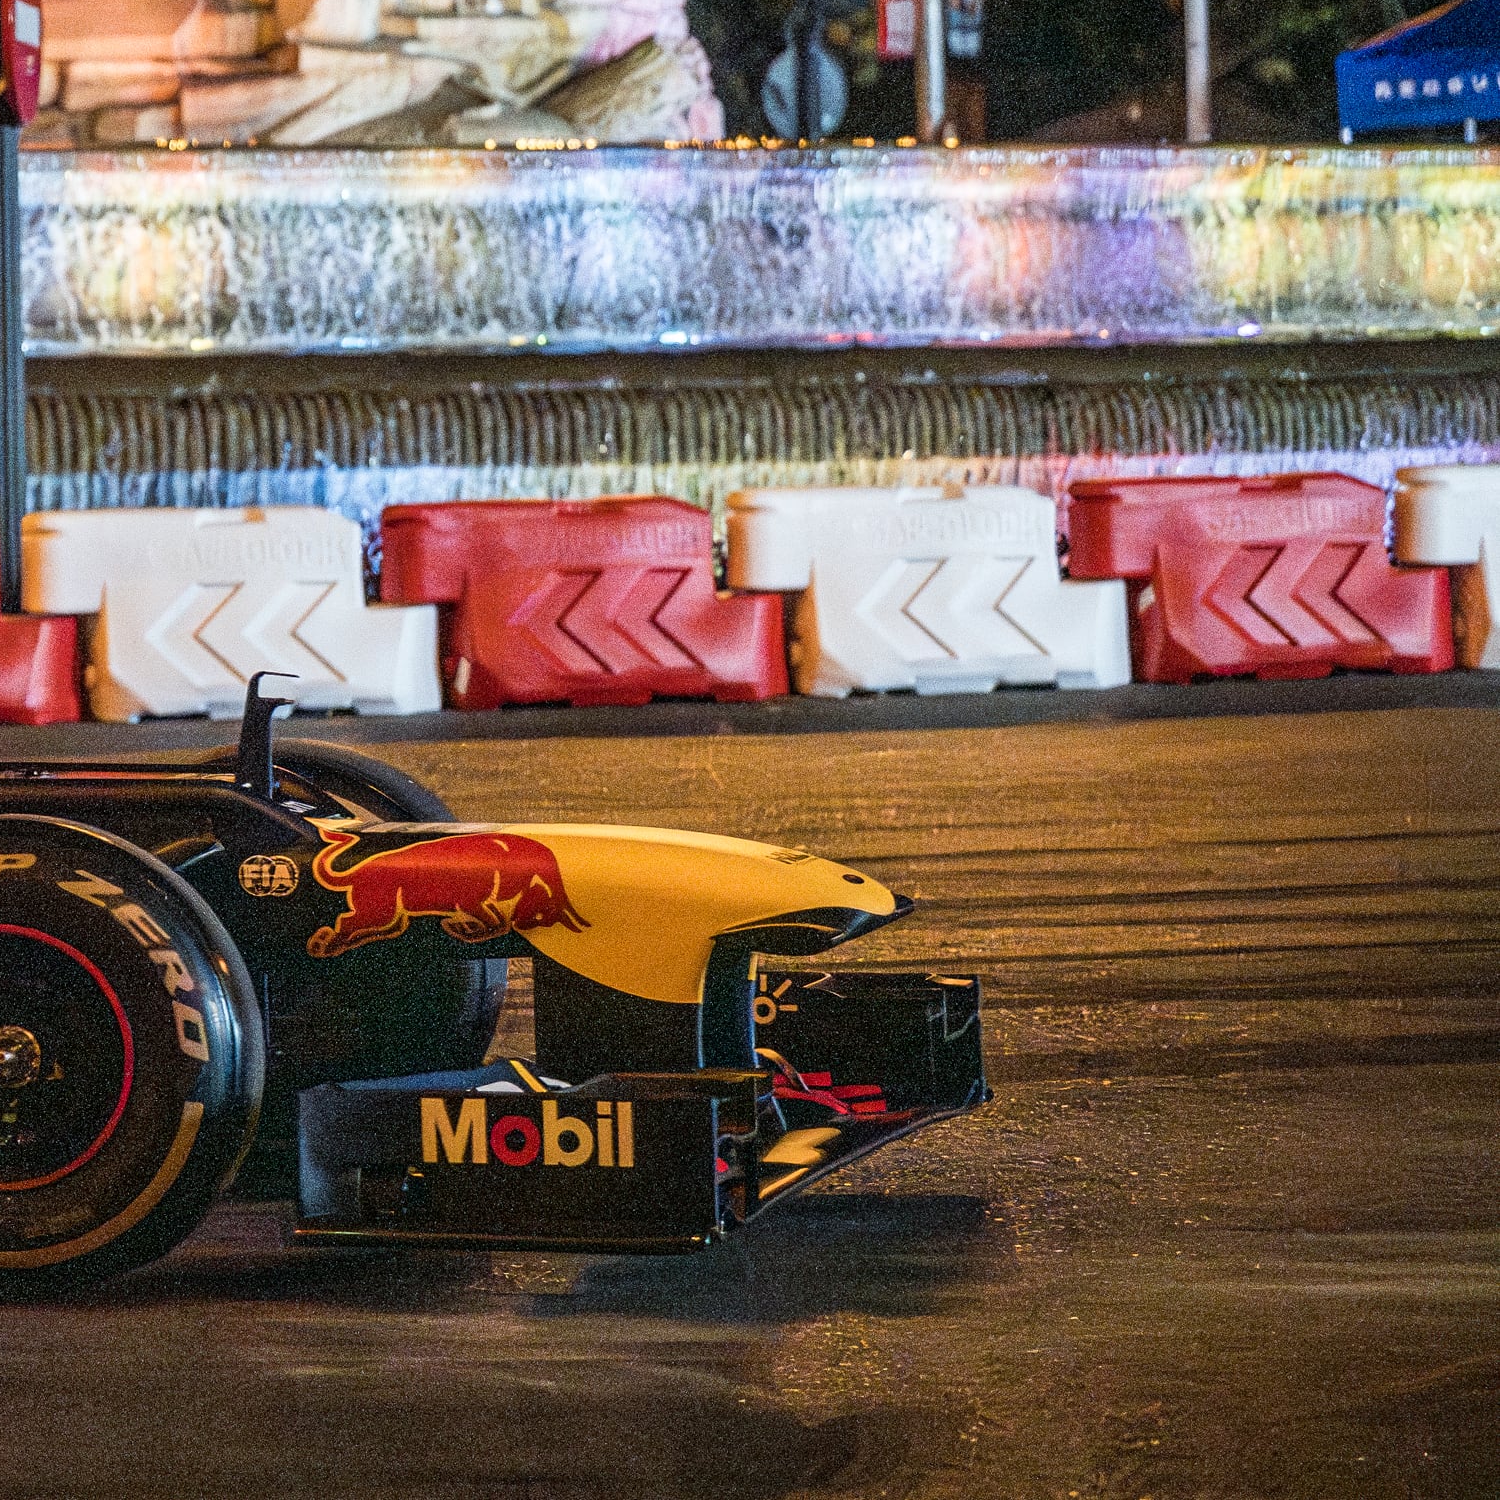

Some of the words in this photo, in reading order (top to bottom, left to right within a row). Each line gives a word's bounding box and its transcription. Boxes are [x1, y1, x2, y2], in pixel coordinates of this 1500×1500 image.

[242, 863, 293, 888] FIA
[56, 868, 210, 1062] ZERO
[420, 1097, 635, 1168] Mobil
